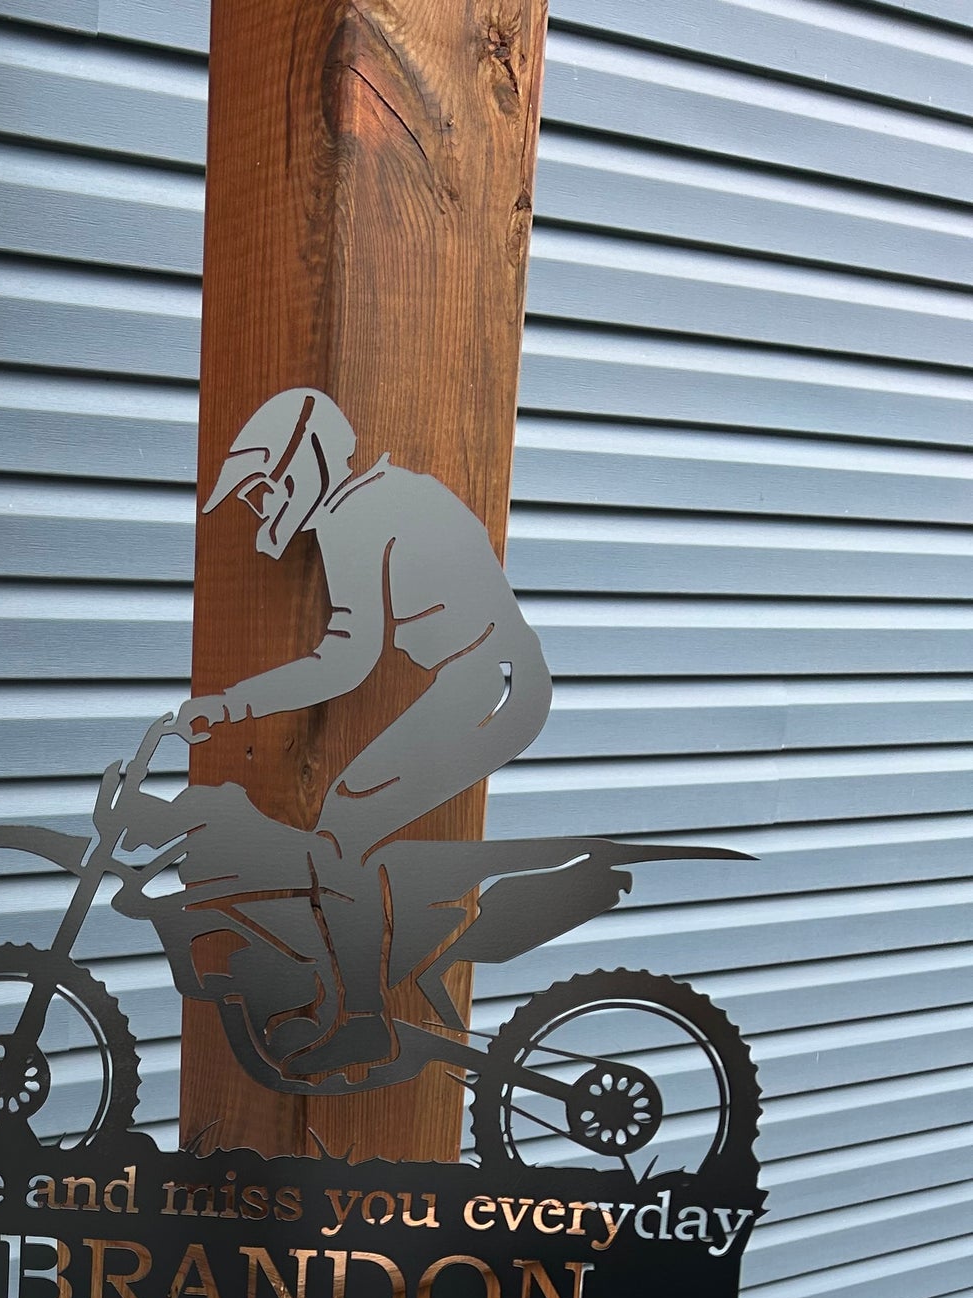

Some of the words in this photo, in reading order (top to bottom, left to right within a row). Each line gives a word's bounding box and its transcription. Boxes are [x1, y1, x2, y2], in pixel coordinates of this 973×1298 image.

[26, 1165, 139, 1214] and
[160, 1171, 304, 1222] miss
[321, 1189, 441, 1236] you
[462, 1190, 753, 1257] everyday
